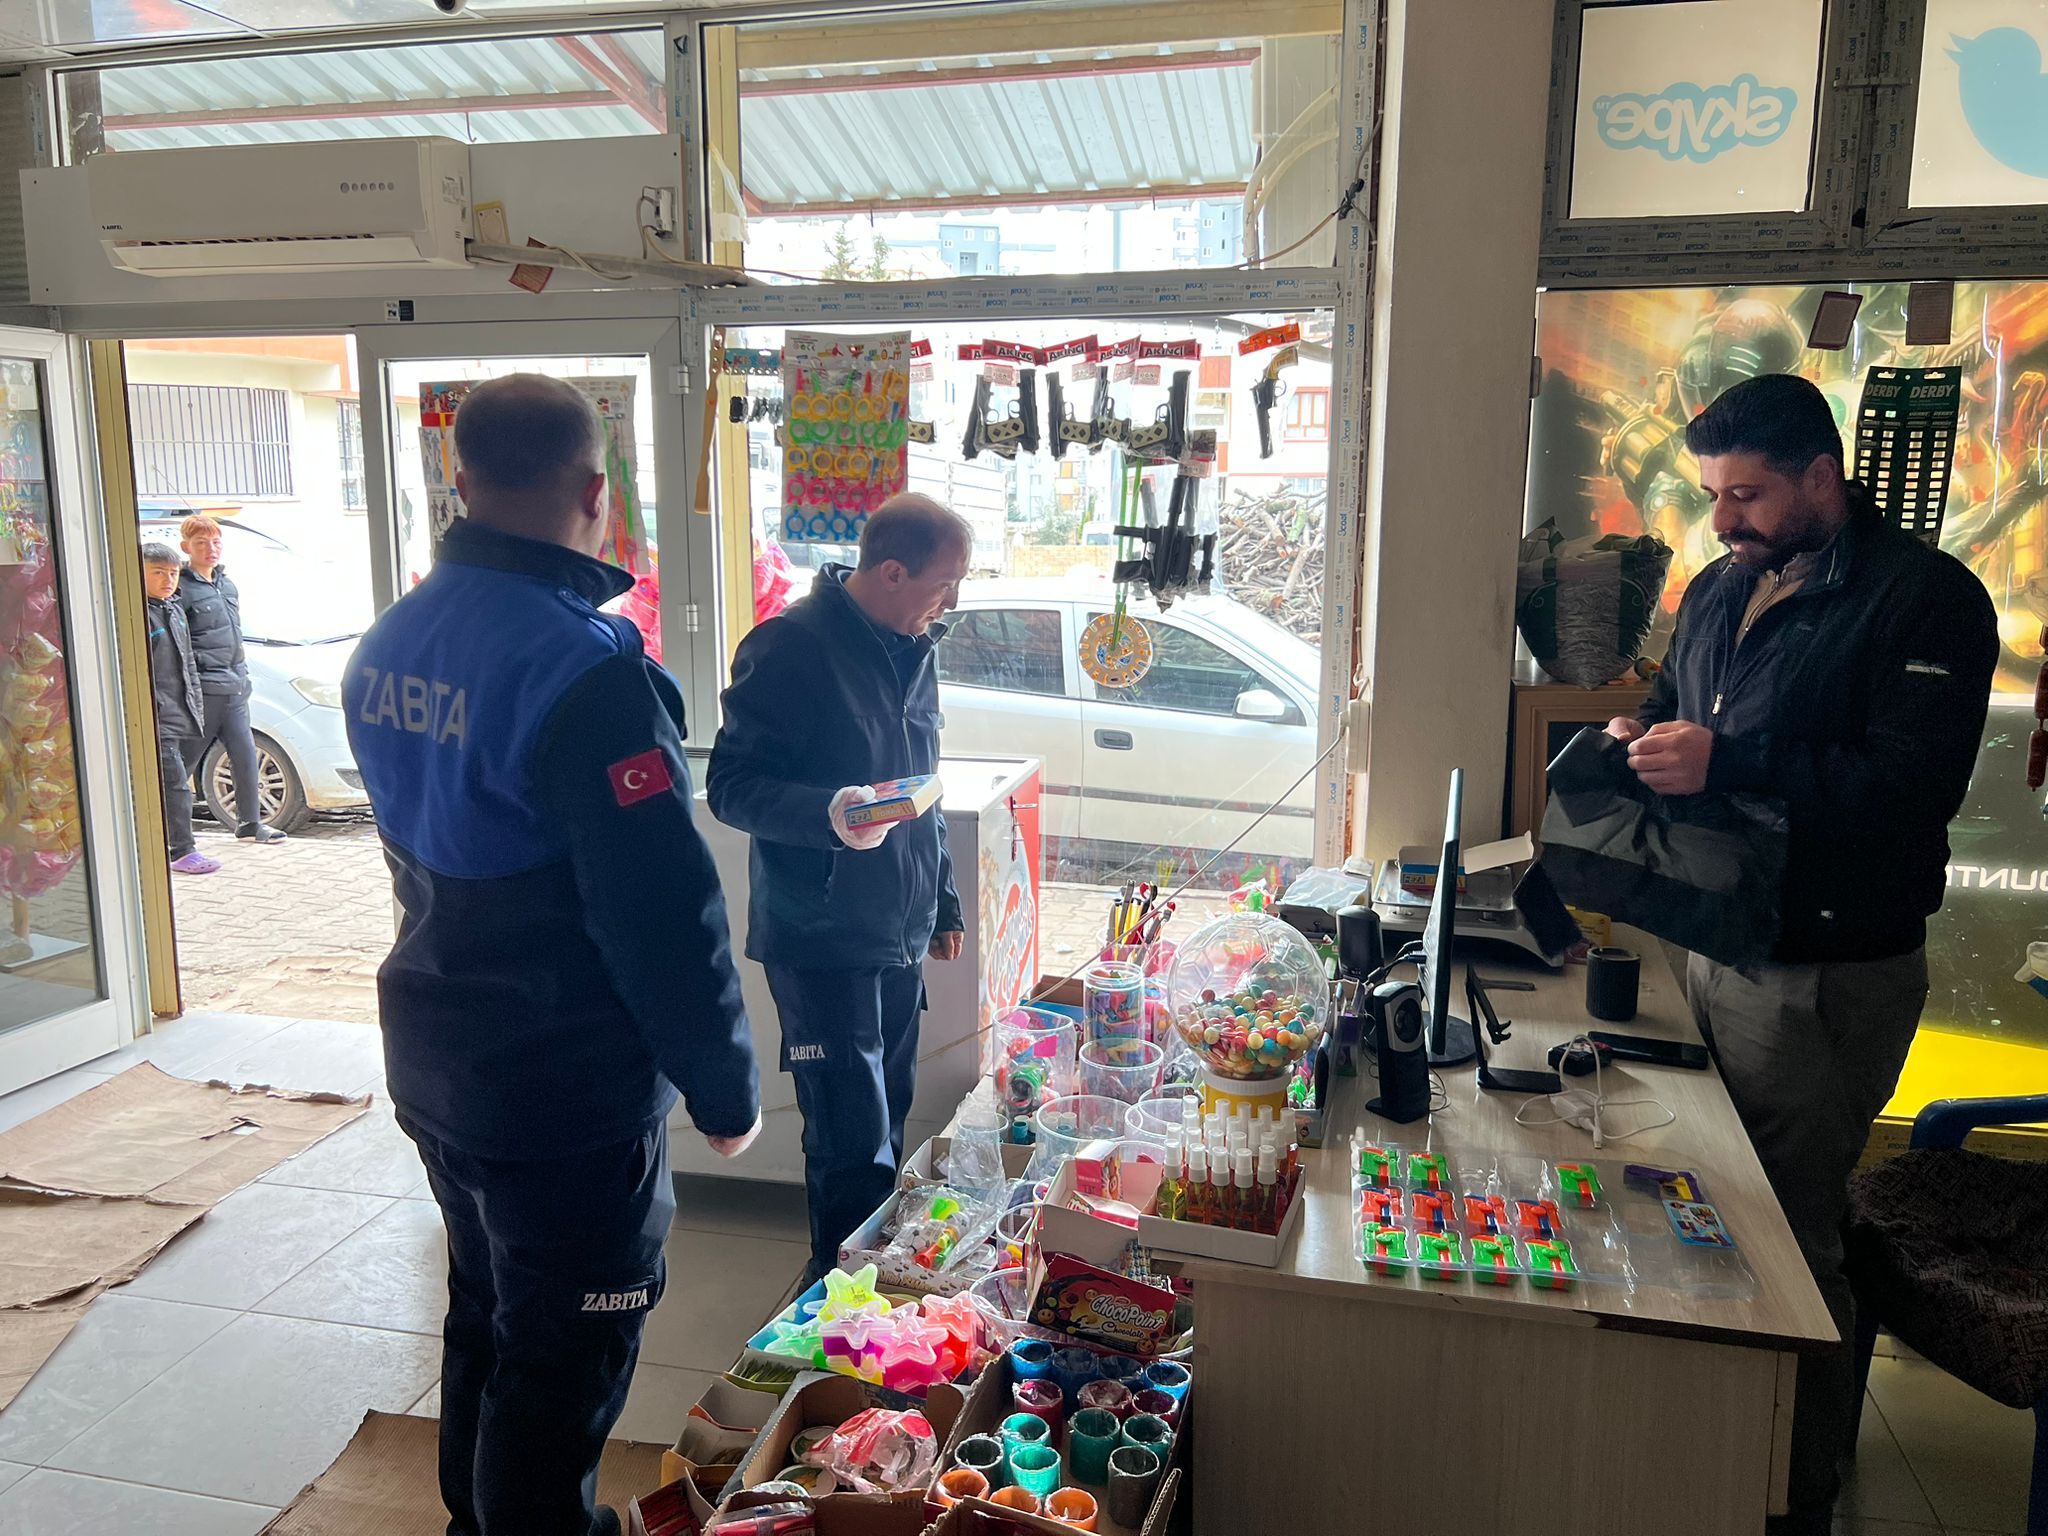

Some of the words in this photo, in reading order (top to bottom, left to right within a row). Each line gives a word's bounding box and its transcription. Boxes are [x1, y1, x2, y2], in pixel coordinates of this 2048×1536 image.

[998, 347, 1034, 361] AKINC
[1145, 347, 1183, 357] AKINCI
[1865, 384, 1902, 398] DERBY
[1909, 384, 1956, 399] DERBY
[360, 667, 467, 750] ZABITA
[790, 1044, 825, 1060] ZABITA
[581, 1288, 648, 1311] ZABITA
